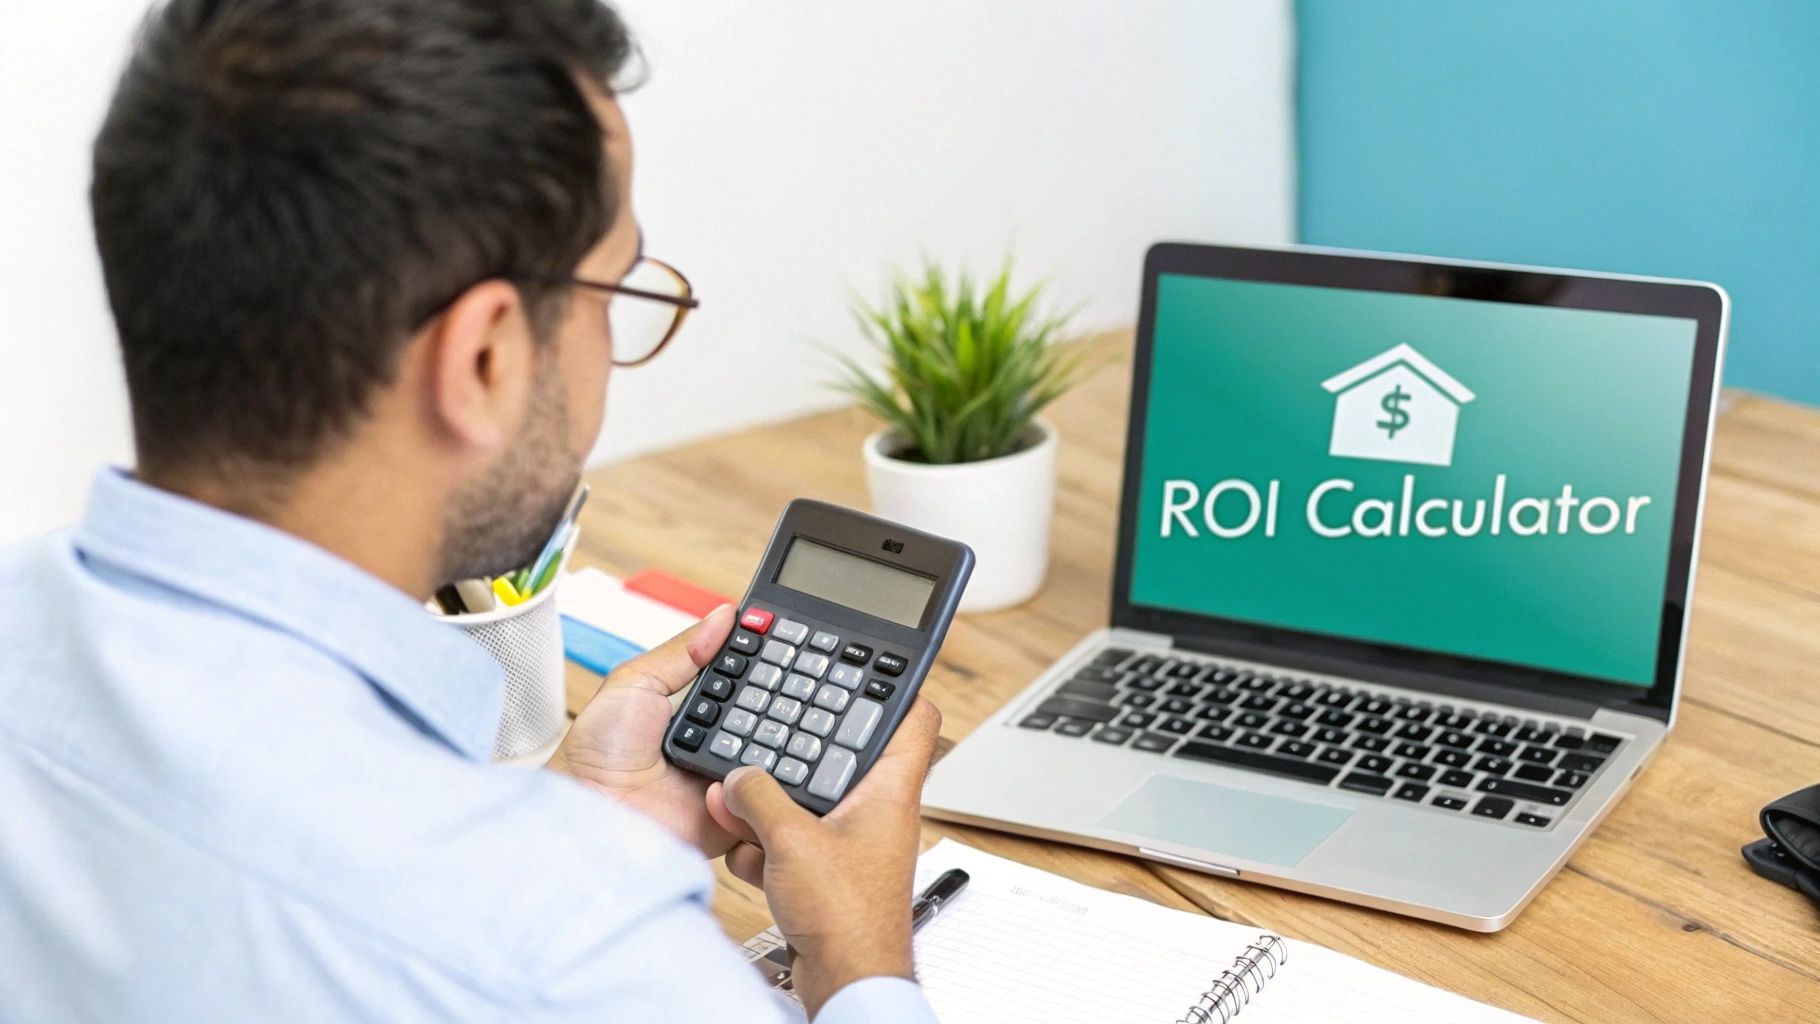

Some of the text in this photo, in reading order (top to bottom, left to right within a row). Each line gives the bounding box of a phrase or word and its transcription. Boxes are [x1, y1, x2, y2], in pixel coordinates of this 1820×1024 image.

[1376, 384, 1412, 440] $
[1160, 474, 1651, 538] ROI Calculator
